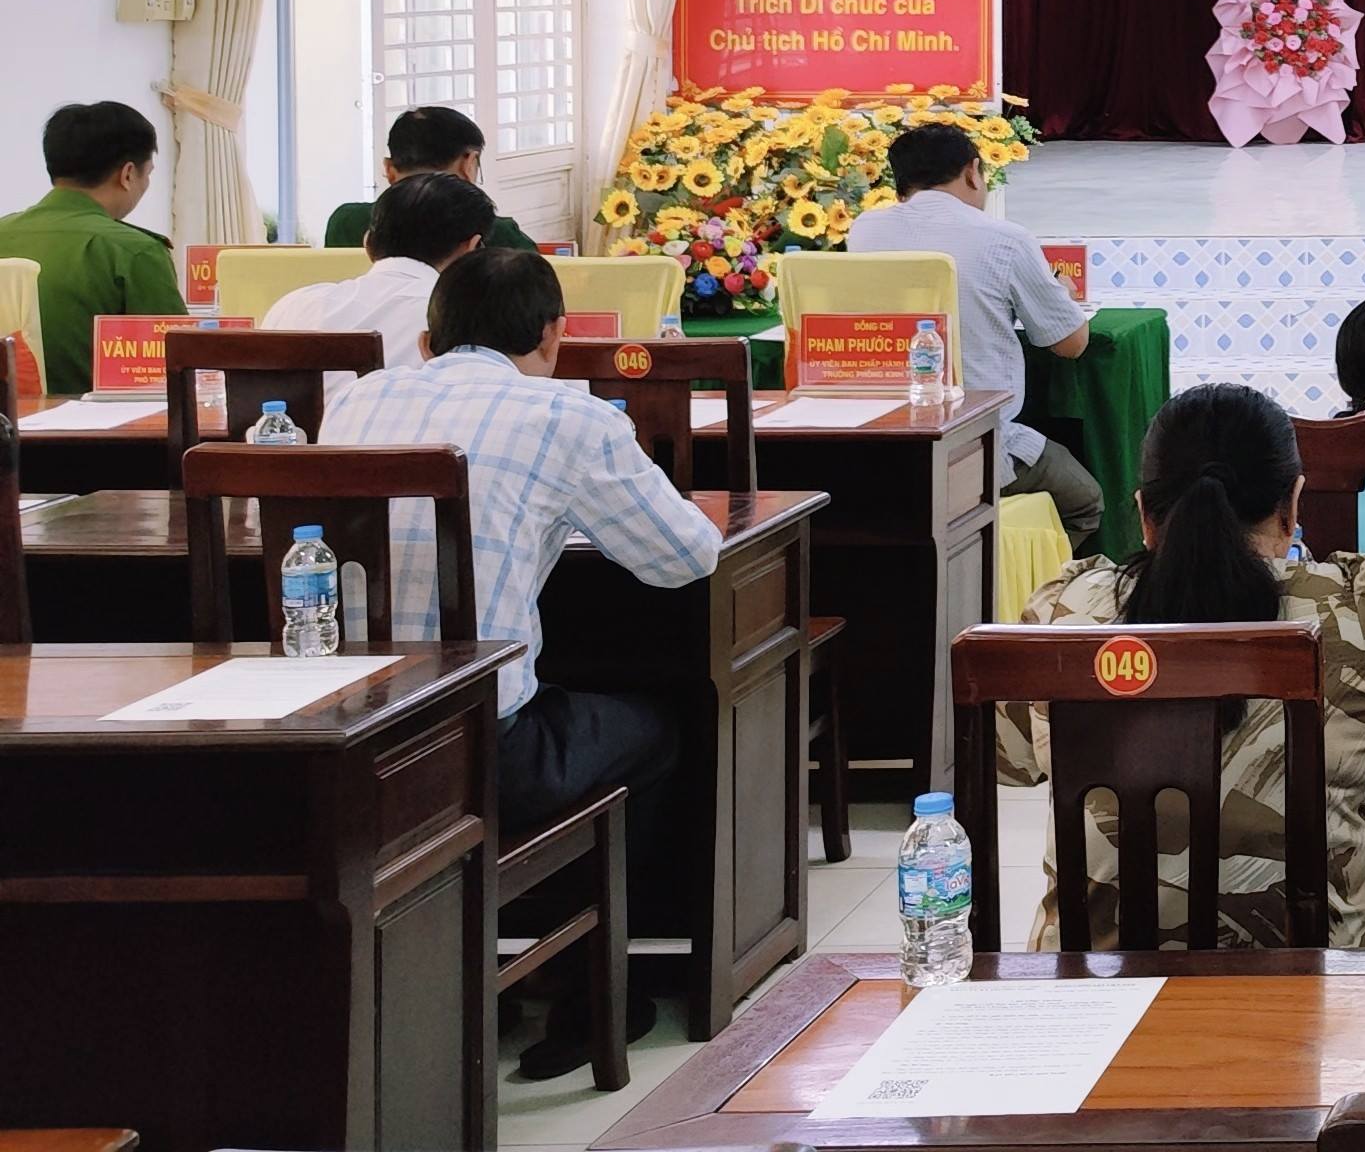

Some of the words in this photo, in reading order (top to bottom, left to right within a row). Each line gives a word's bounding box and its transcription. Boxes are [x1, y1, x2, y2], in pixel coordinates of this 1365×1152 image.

[710, 28, 755, 51] Chủ
[763, 30, 805, 55] tịch
[813, 26, 845, 51] Hồ
[852, 28, 890, 51] Chí
[897, 30, 959, 52] Minh.
[191, 261, 211, 280] VÕ
[102, 337, 137, 358] VĂN
[808, 338, 844, 354] PHẠM
[848, 335, 892, 352] PHƯỚC
[619, 353, 648, 370] 046
[1101, 651, 1150, 680] 049
